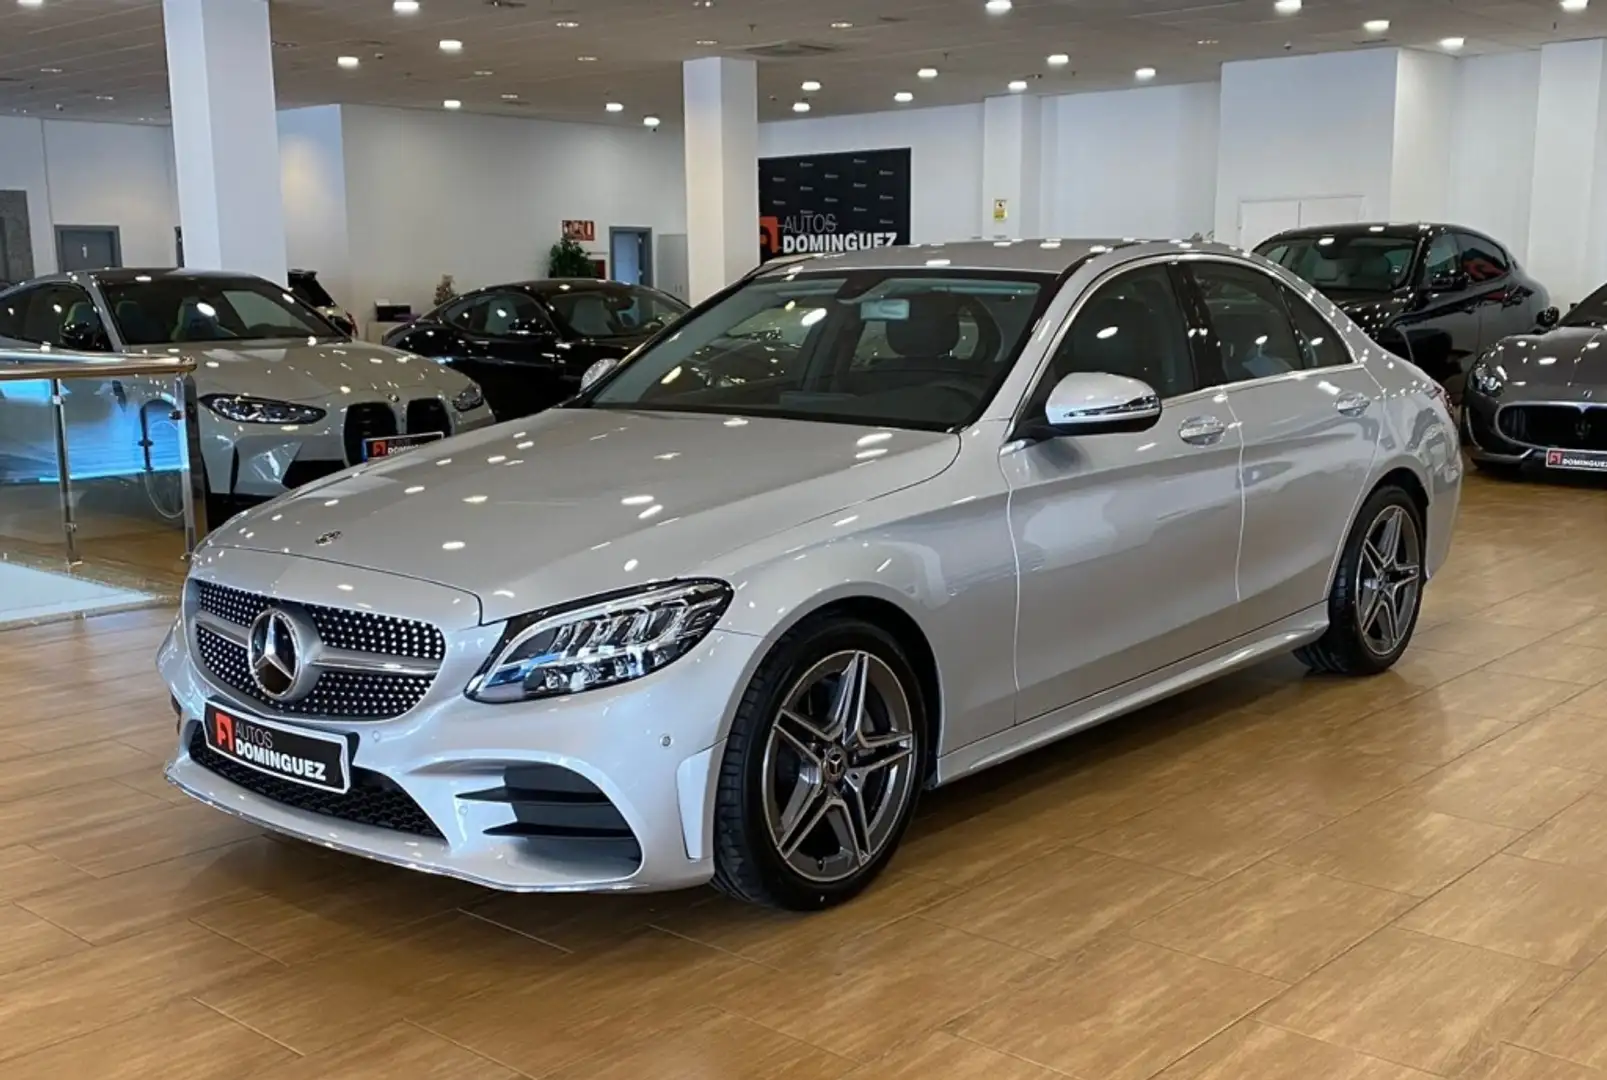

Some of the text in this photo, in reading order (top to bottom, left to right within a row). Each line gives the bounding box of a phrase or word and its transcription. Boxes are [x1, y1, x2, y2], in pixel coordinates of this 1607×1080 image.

[783, 214, 836, 233] AUTOS
[783, 232, 897, 253] DOMINGUEZ
[235, 721, 273, 748] AUTOS
[235, 738, 327, 781] DOMINGUEZ
